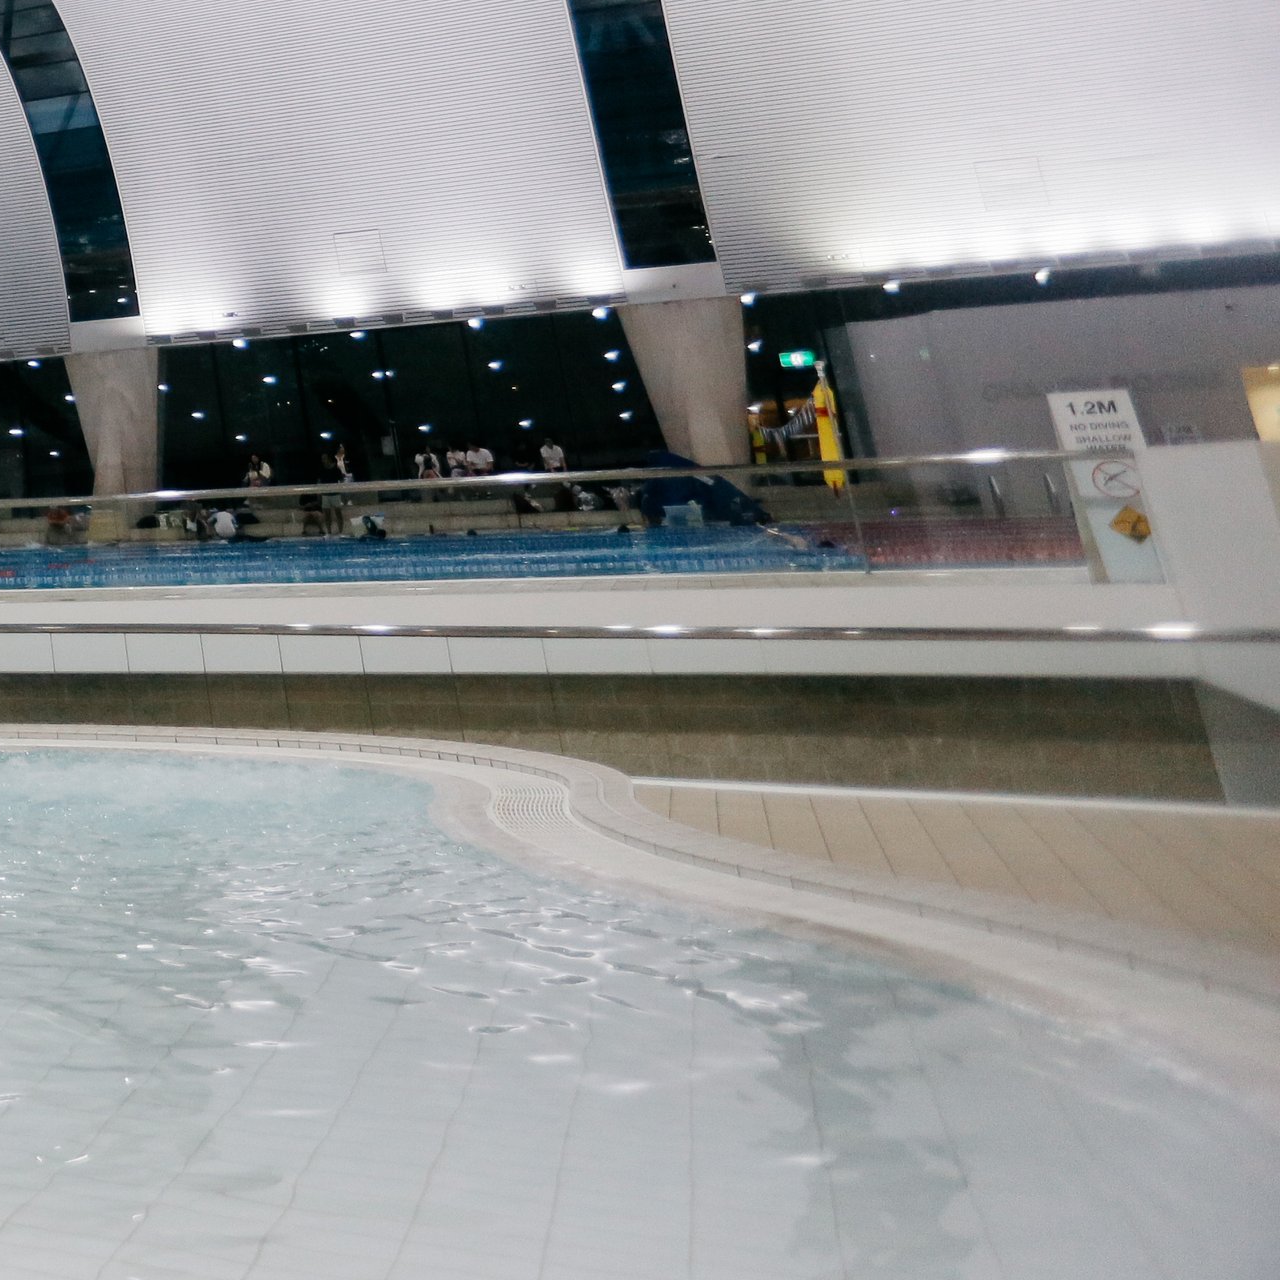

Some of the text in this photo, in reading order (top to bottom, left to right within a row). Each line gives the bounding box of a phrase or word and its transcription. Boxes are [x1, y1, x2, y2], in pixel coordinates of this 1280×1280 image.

[1066, 400, 1117, 416] 1.2M
[1070, 421, 1129, 432] NO DIVING
[1075, 433, 1132, 444] SHALLOW
